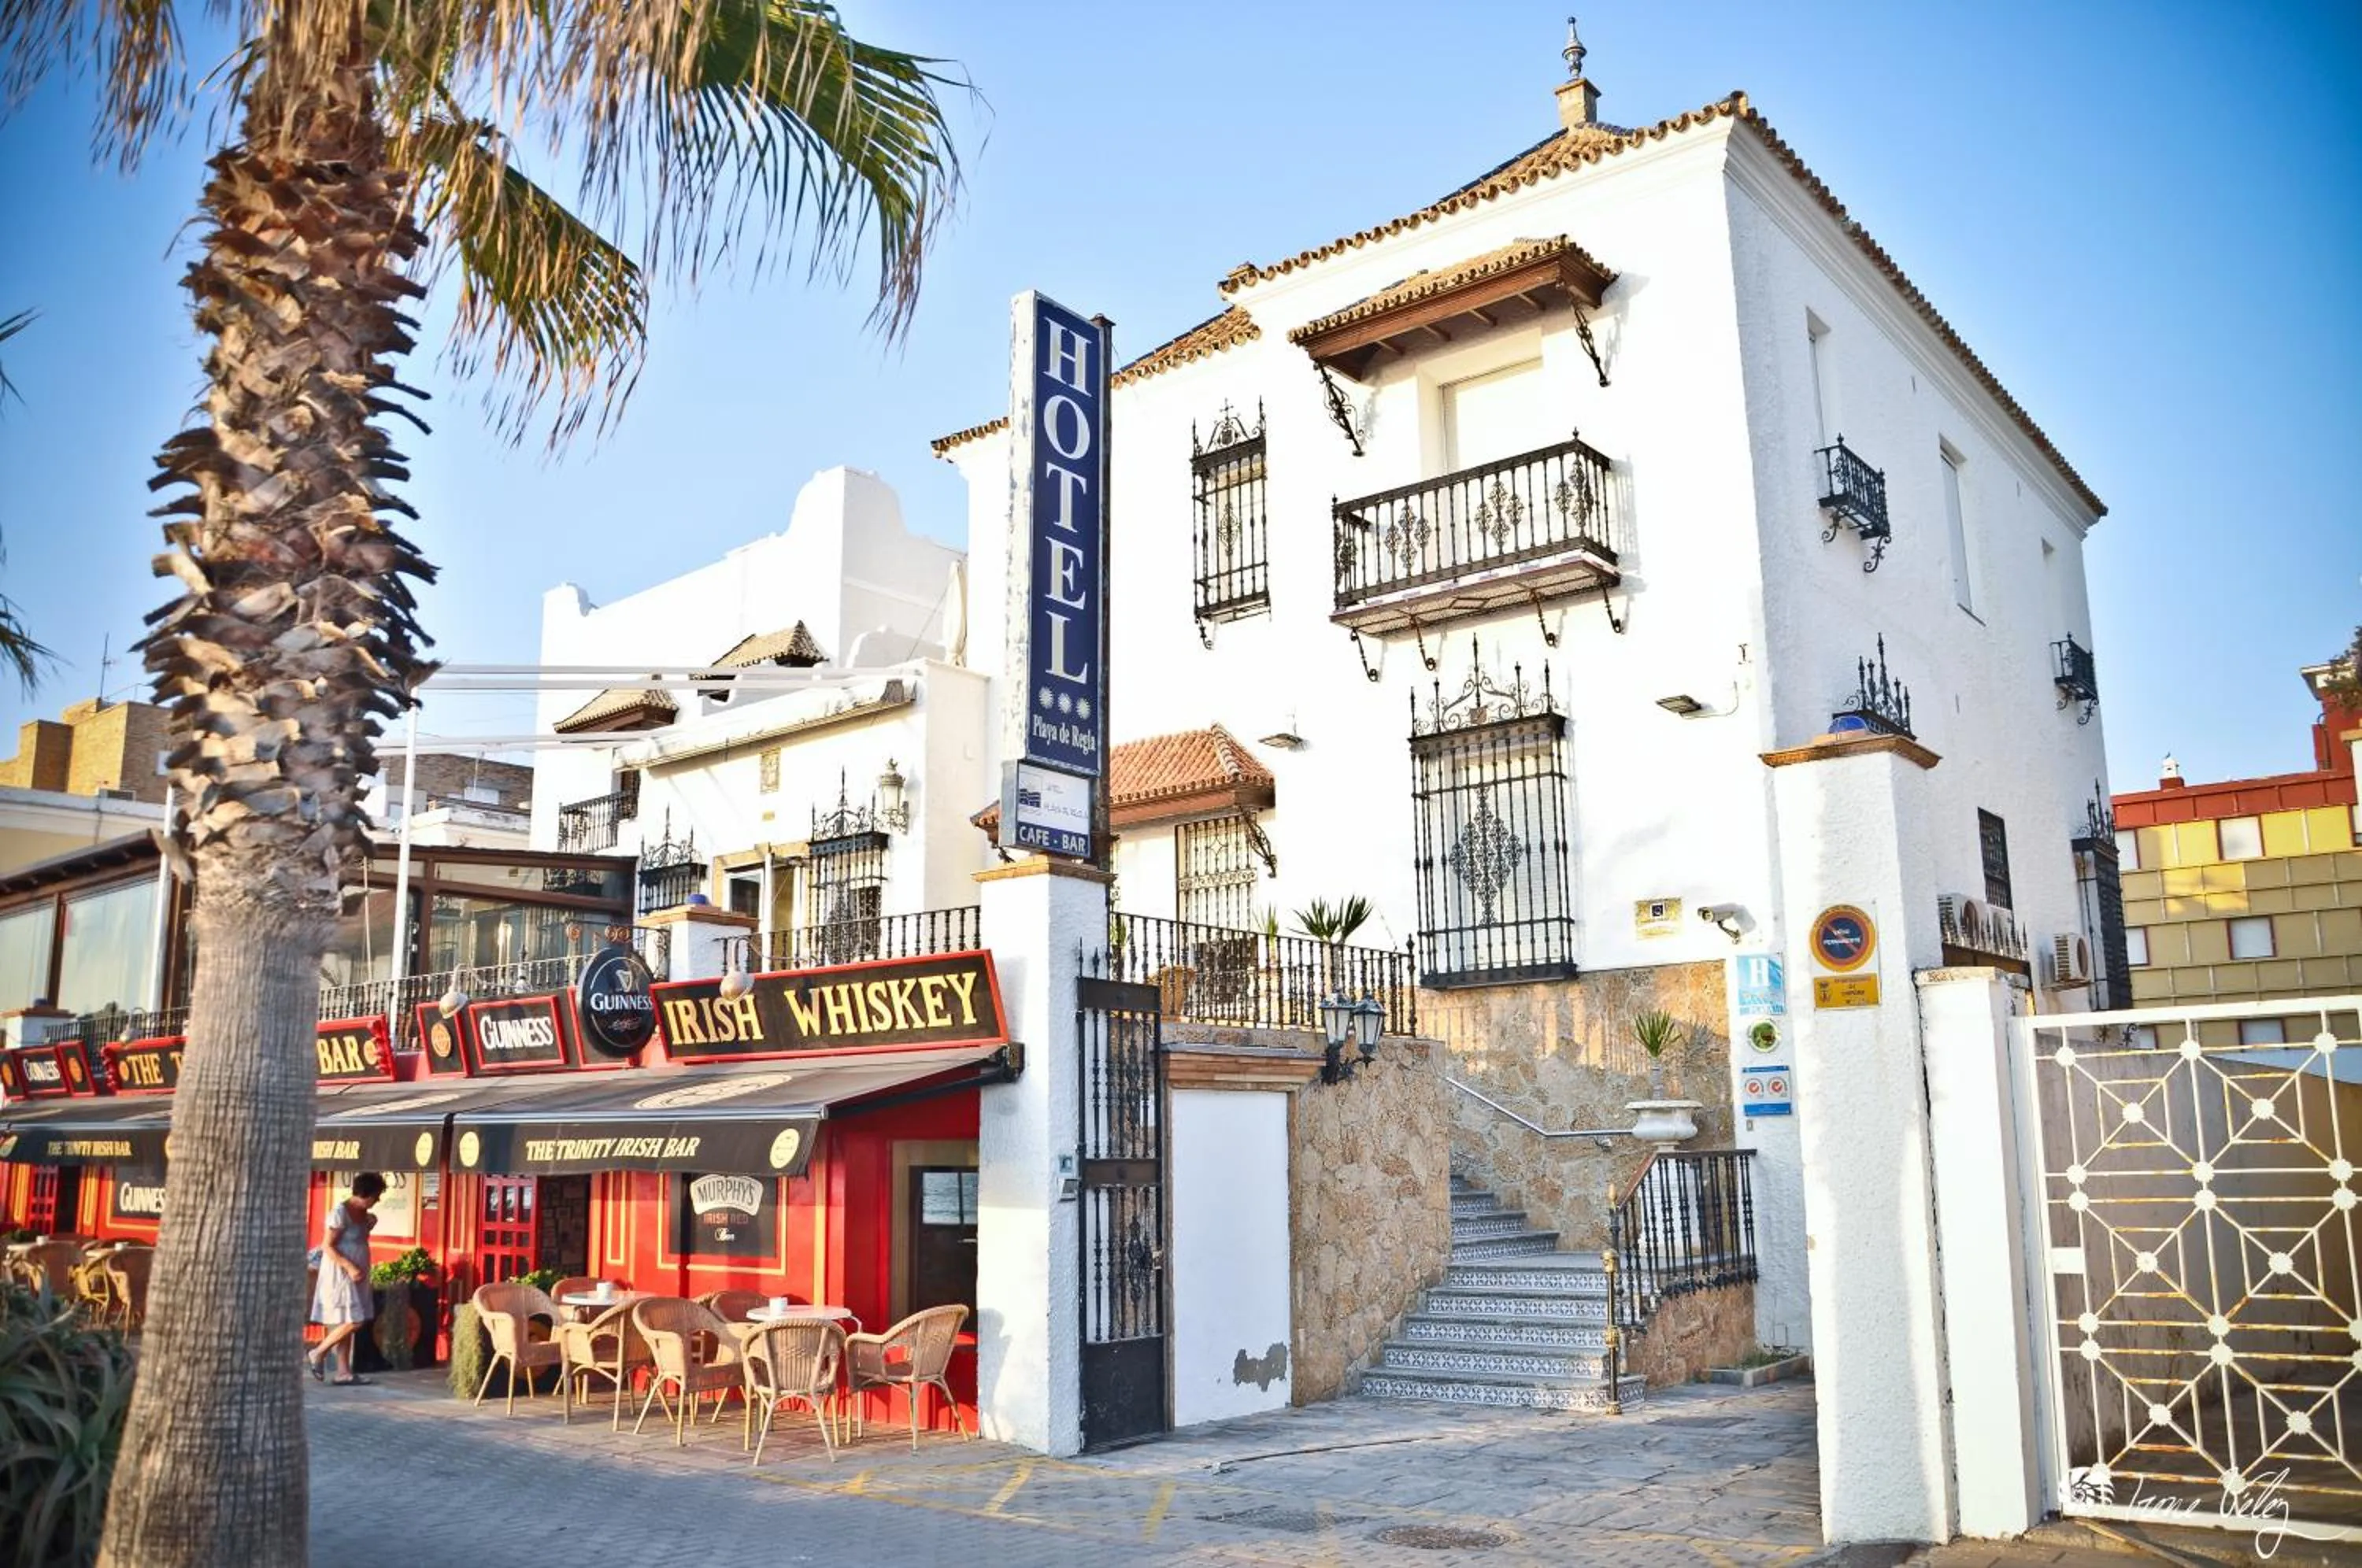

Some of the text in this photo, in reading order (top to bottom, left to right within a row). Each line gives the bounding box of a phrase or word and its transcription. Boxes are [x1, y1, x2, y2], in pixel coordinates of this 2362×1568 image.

[1043, 315, 1093, 685] HOTEL
[1033, 713, 1096, 756] Playa de Regla
[1019, 826, 1087, 854] CAFE BAR
[590, 992, 653, 1011] GUINNESS
[663, 971, 978, 1046] IRISH WHISKEY
[479, 1015, 554, 1050] GUINNESS
[127, 1052, 165, 1085] THE
[316, 1035, 365, 1074] BAR
[333, 1141, 360, 1159] BAR
[525, 1137, 702, 1161] THE TRINITY IRISH BAR
[119, 1182, 167, 1212] GUINNES
